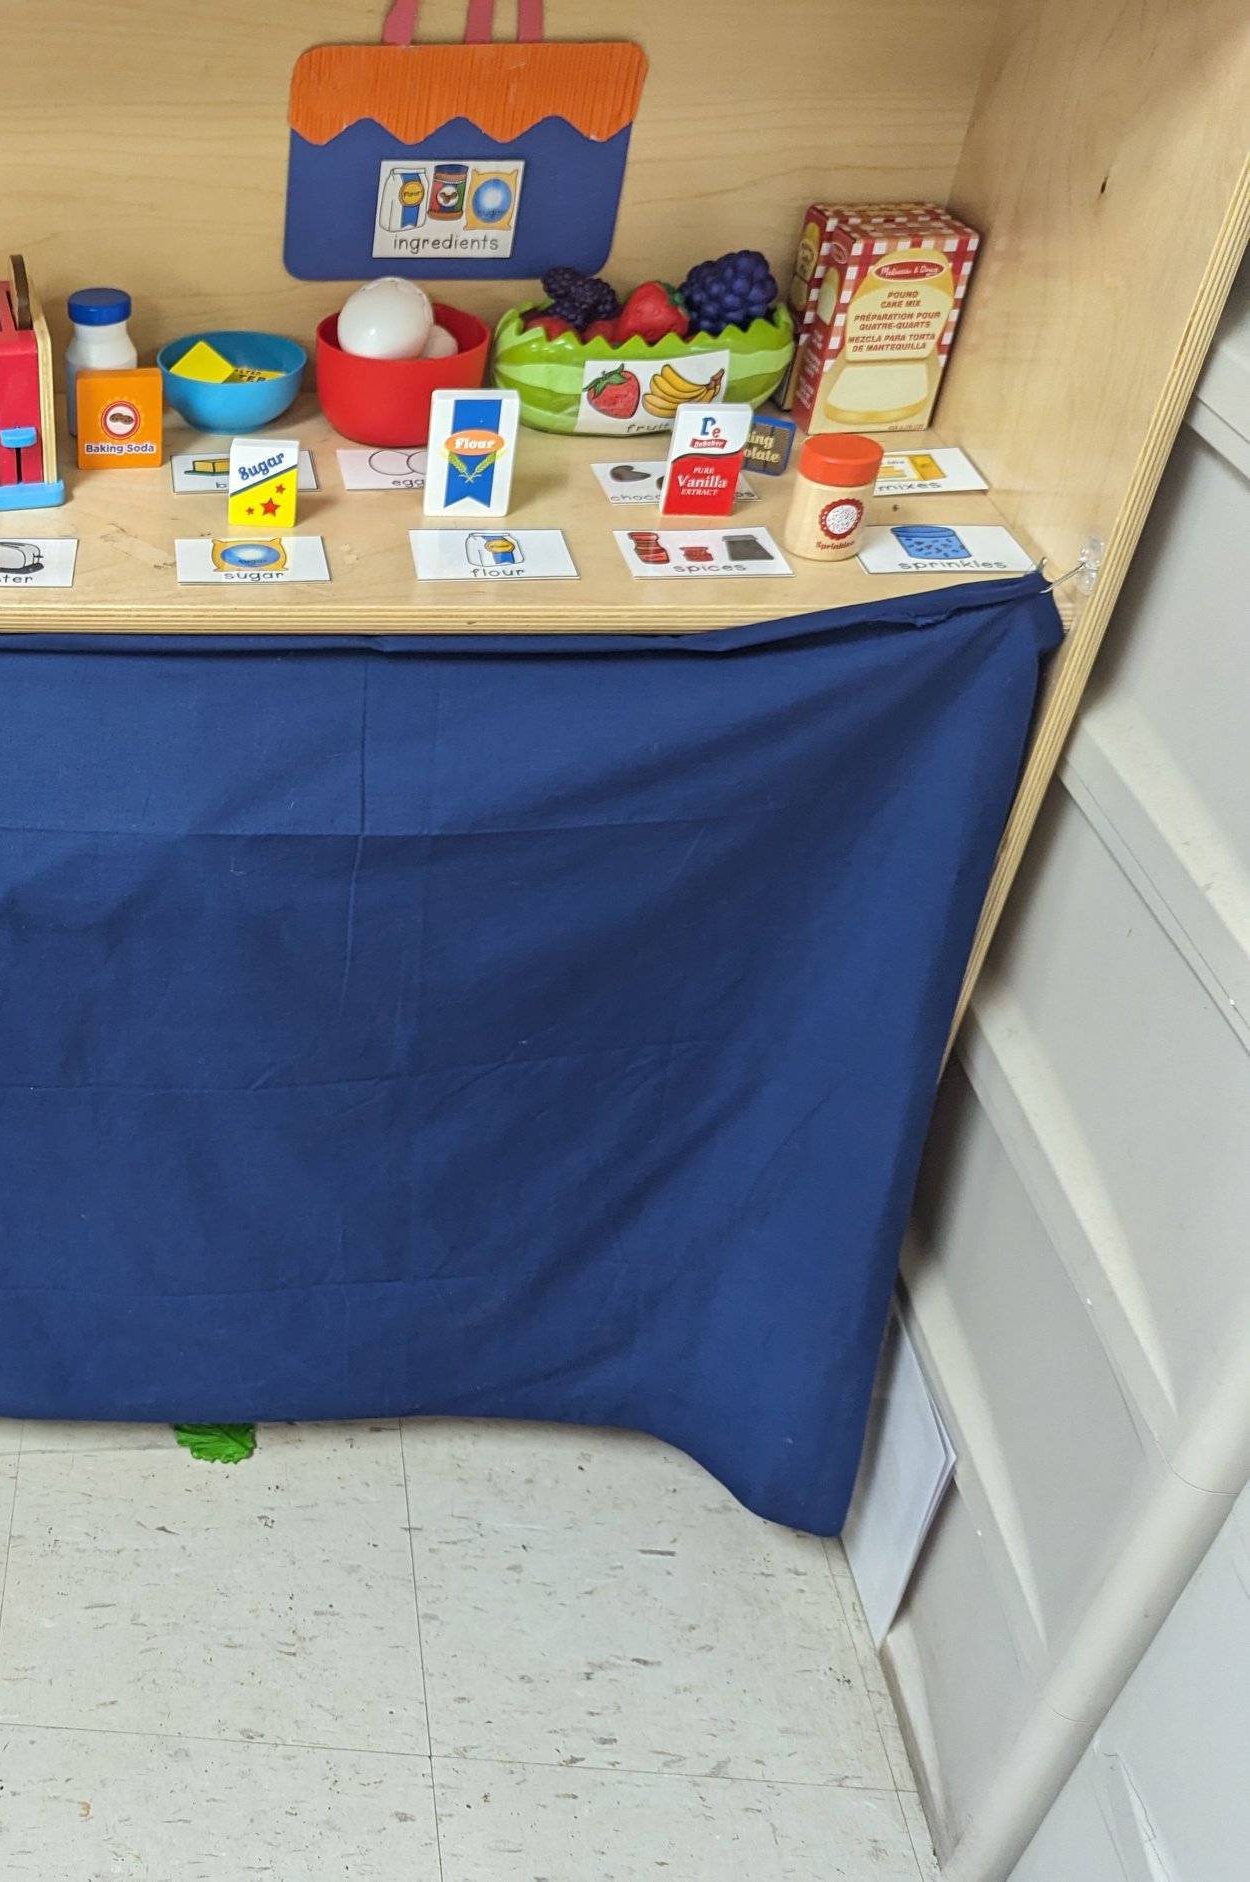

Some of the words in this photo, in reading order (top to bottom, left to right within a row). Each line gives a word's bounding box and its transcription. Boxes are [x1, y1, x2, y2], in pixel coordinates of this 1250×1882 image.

[393, 233, 499, 255] ingredients
[887, 291, 919, 299] POUND
[880, 300, 903, 308] CAKE
[905, 300, 921, 308] MIX
[854, 311, 915, 321] PRÉPARATION
[916, 311, 941, 319] POUR
[859, 321, 931, 331] QUATRE-QUARTS
[848, 334, 882, 343] MEZCLA
[884, 334, 906, 342] PARA
[908, 333, 935, 341] TORTA
[866, 342, 926, 352] MANTEQUILLA
[85, 444, 124, 454] Baking
[127, 443, 155, 453] Soda
[454, 438, 496, 449] Flour
[238, 452, 285, 481] Sugar
[678, 475, 728, 489] Vanilla
[877, 482, 942, 491] mixes
[680, 488, 719, 496] EXTRACT
[815, 539, 856, 550] Sprinkles
[672, 564, 747, 574] spices
[897, 559, 1008, 570] sprinkles
[224, 572, 284, 582] sugar
[470, 568, 525, 578] flour
